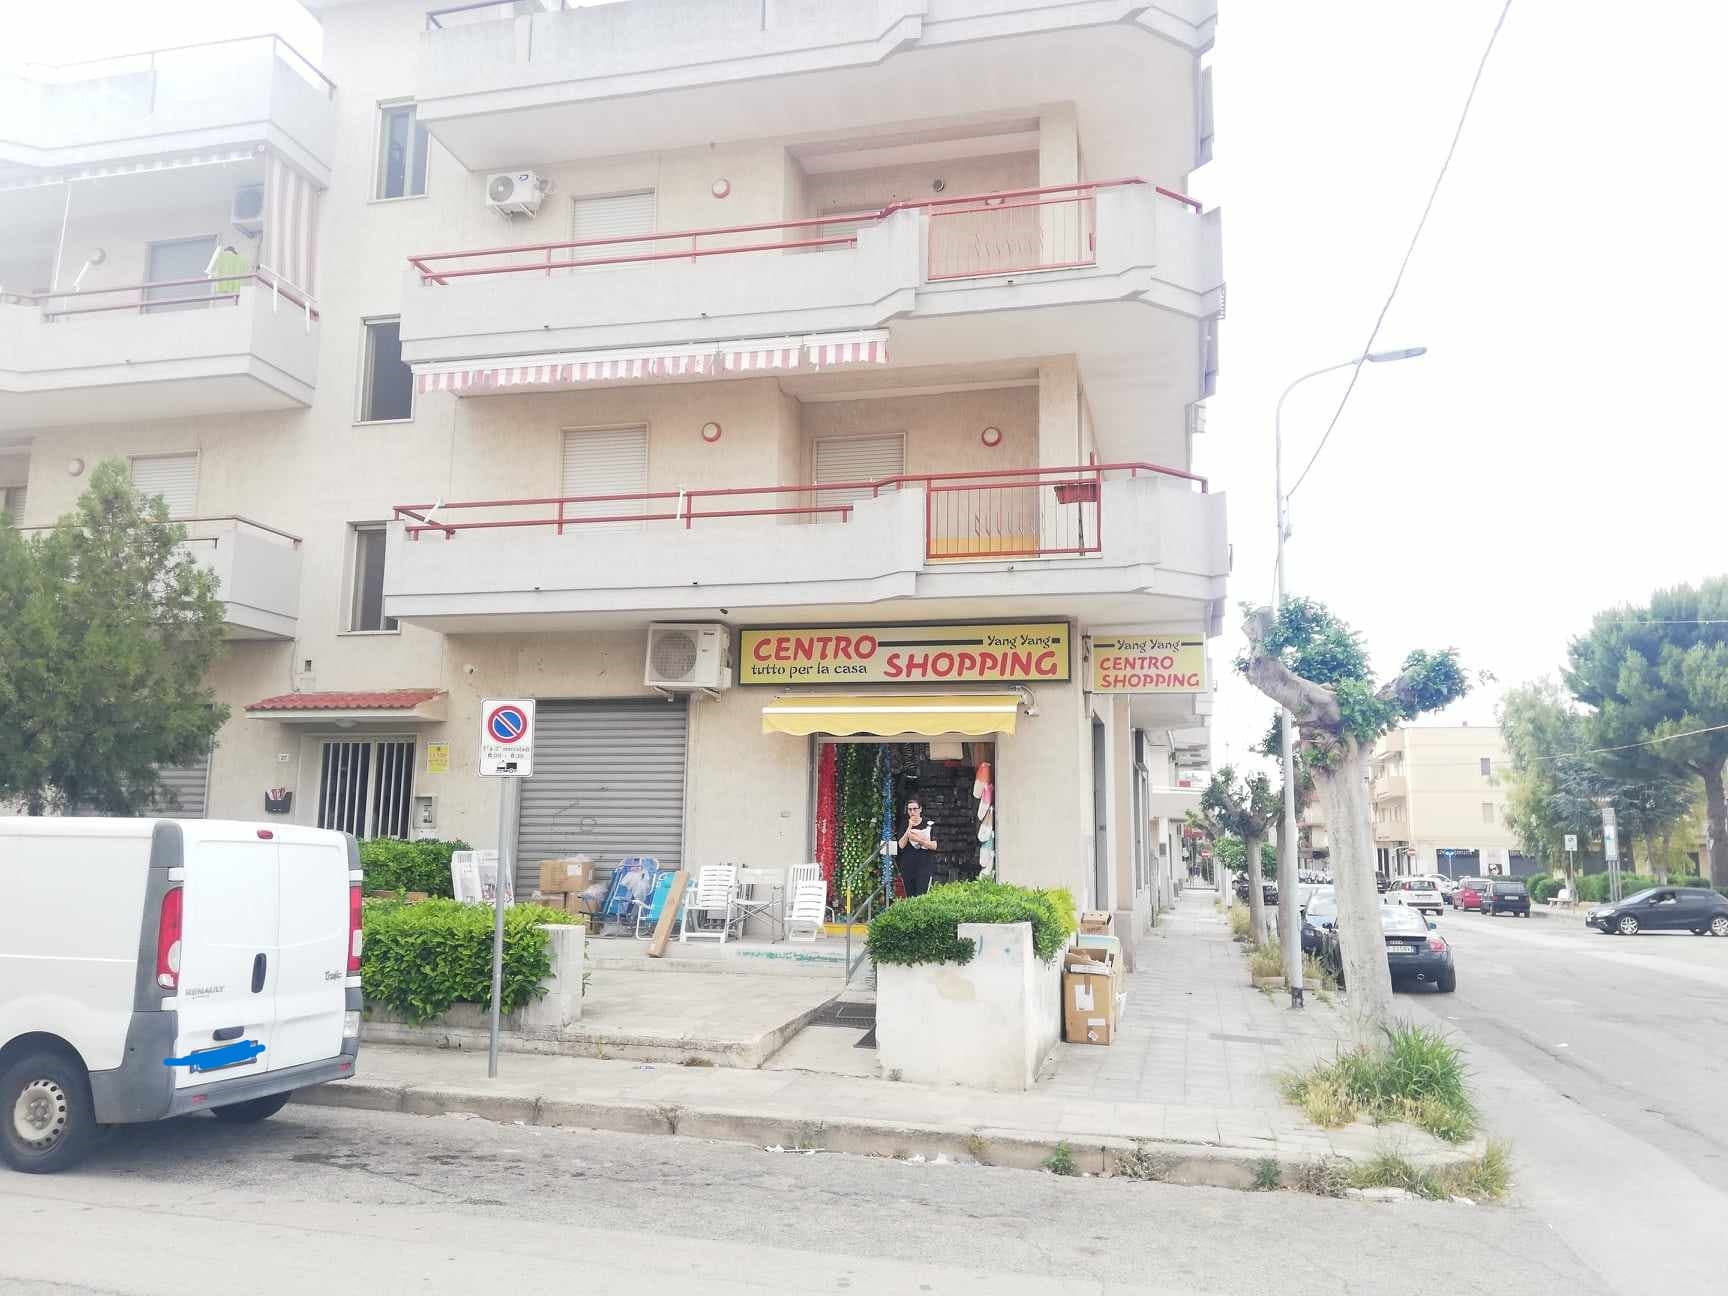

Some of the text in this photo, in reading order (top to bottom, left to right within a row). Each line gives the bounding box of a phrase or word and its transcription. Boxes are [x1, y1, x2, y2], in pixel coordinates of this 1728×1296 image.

[753, 634, 878, 662] CENTRO
[987, 634, 1051, 649] Yang Yang
[1117, 639, 1180, 653] Yang Yang
[752, 662, 867, 678] tutto per la casa
[883, 650, 1058, 678] SHOPPING
[1100, 655, 1174, 670] CENTRO
[1100, 673, 1199, 688] SHOPPING
[185, 984, 225, 996] RENAULT
